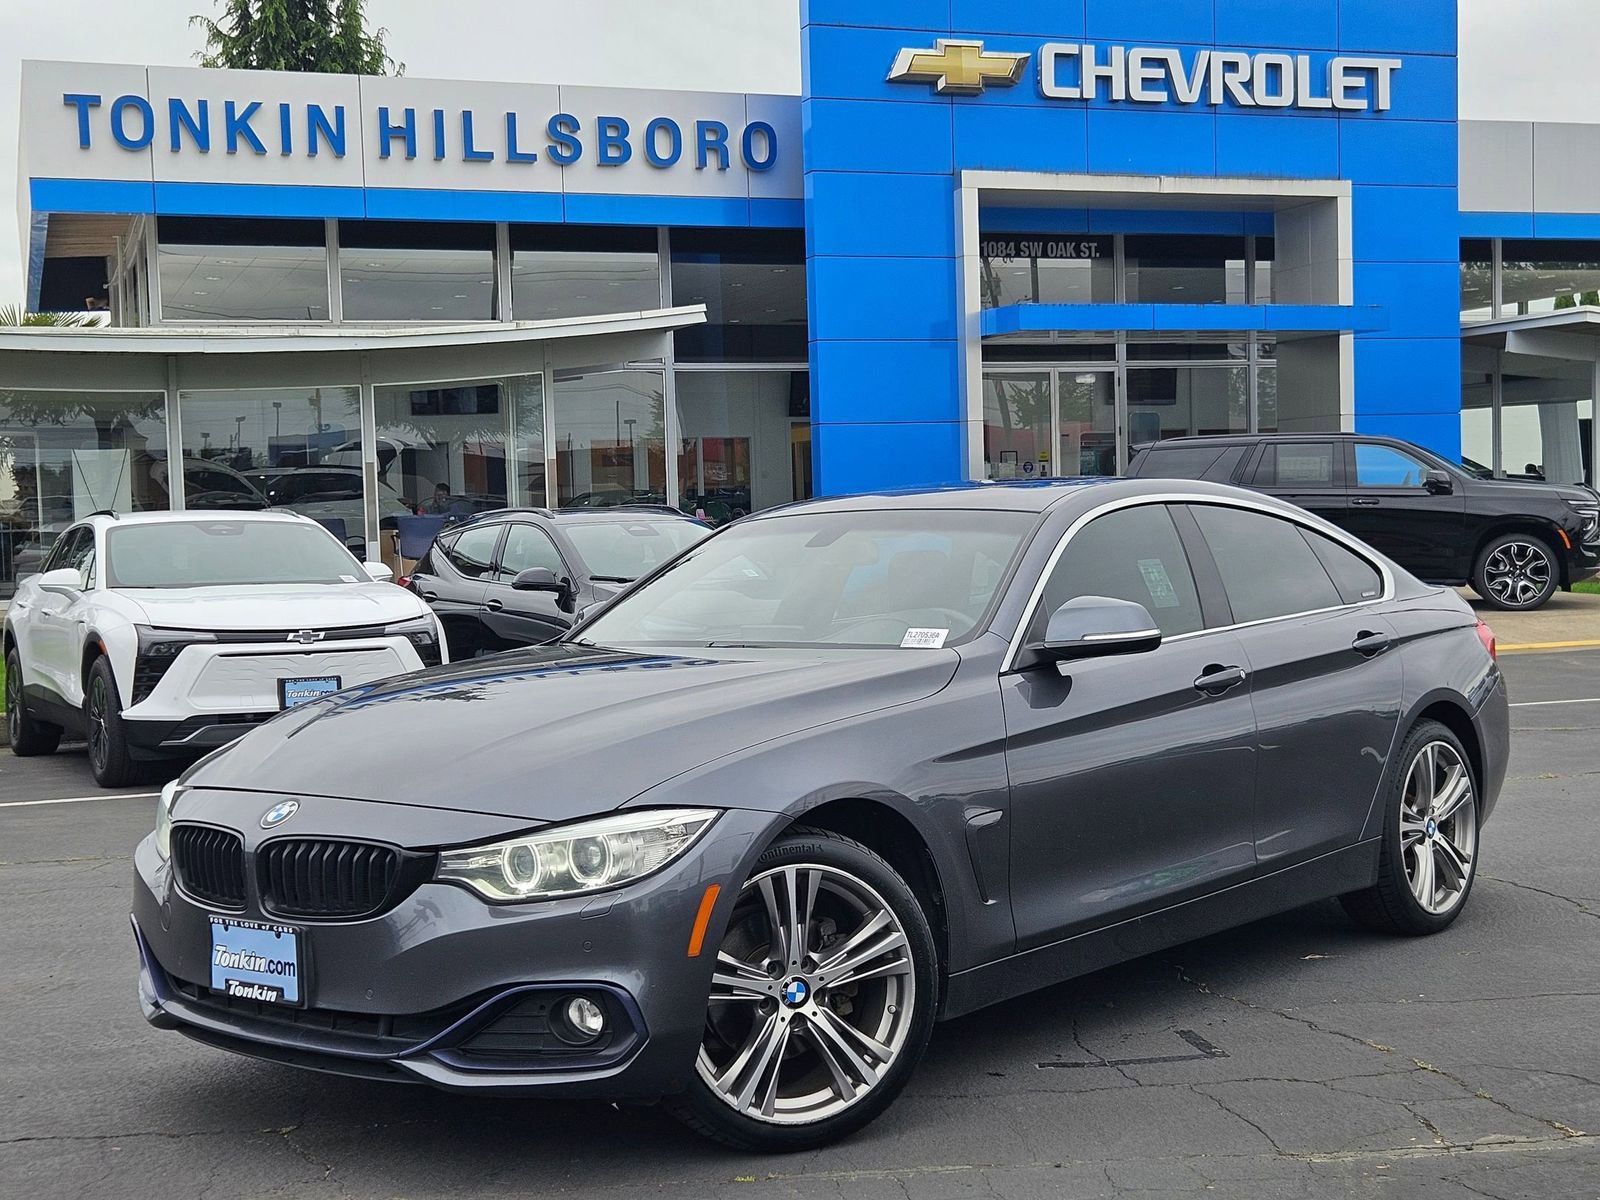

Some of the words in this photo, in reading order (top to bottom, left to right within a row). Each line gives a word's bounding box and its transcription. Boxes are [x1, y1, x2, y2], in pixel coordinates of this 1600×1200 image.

[1038, 41, 1402, 111] CHEVROLET
[62, 93, 346, 158] TONKIN
[377, 105, 779, 172] HILLSBORO
[981, 240, 1016, 257] 1084
[1020, 242, 1043, 257] SW
[1047, 242, 1077, 258] OAK
[1080, 242, 1100, 258] ST.
[225, 919, 239, 927] THE
[240, 921, 258, 929] LOVE
[272, 926, 294, 934] CARS
[214, 944, 296, 977] Tonkin.com
[228, 980, 277, 1002] Tonkin
